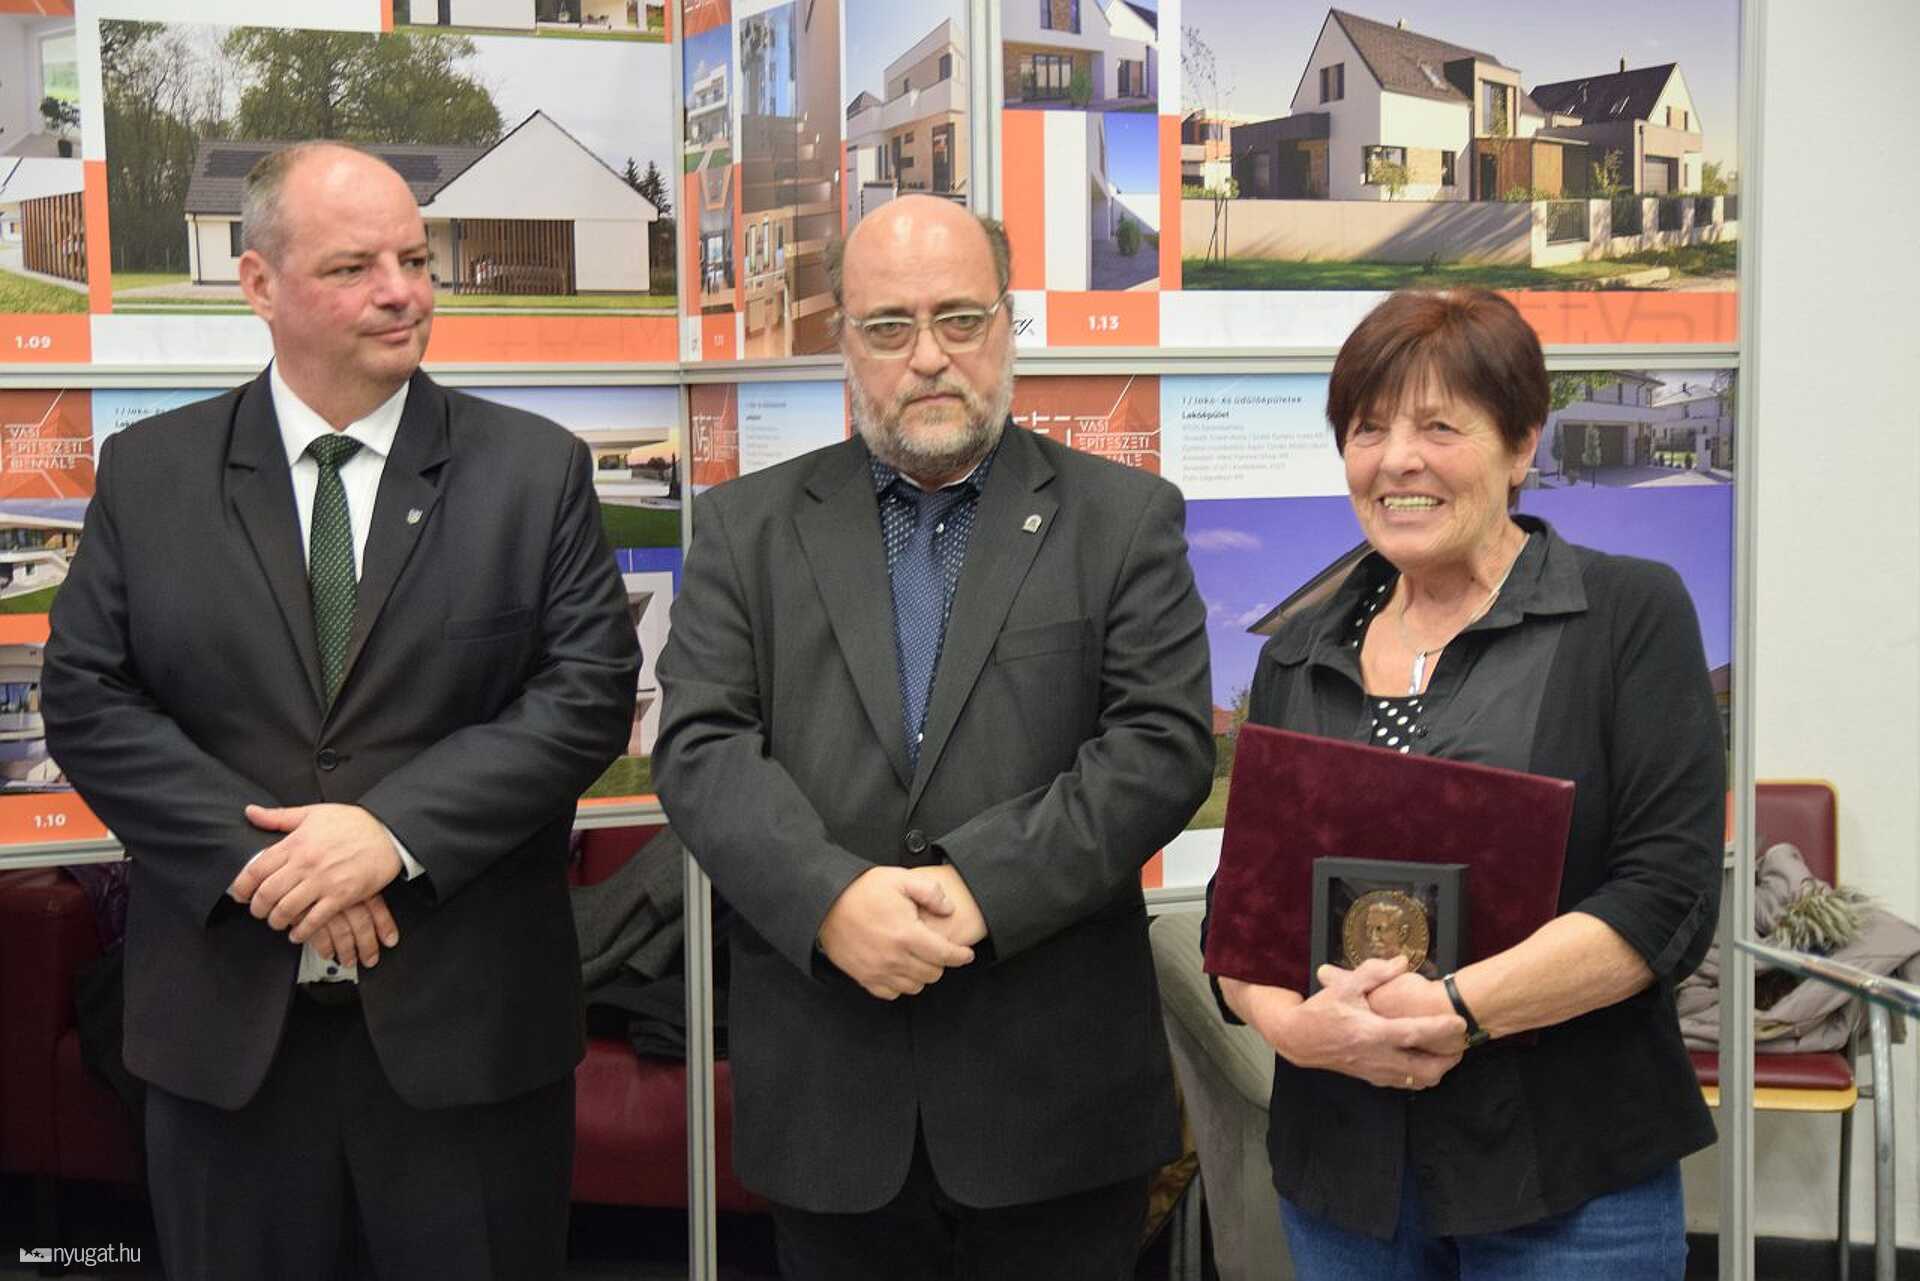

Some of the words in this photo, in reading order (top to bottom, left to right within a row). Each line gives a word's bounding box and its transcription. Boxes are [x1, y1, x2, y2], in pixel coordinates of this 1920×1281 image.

[1087, 314, 1121, 331] 1.13
[15, 335, 52, 349] 1.09
[9, 426, 40, 439] VASI
[1079, 419, 1110, 433] VASI
[34, 812, 67, 829] 1.10
